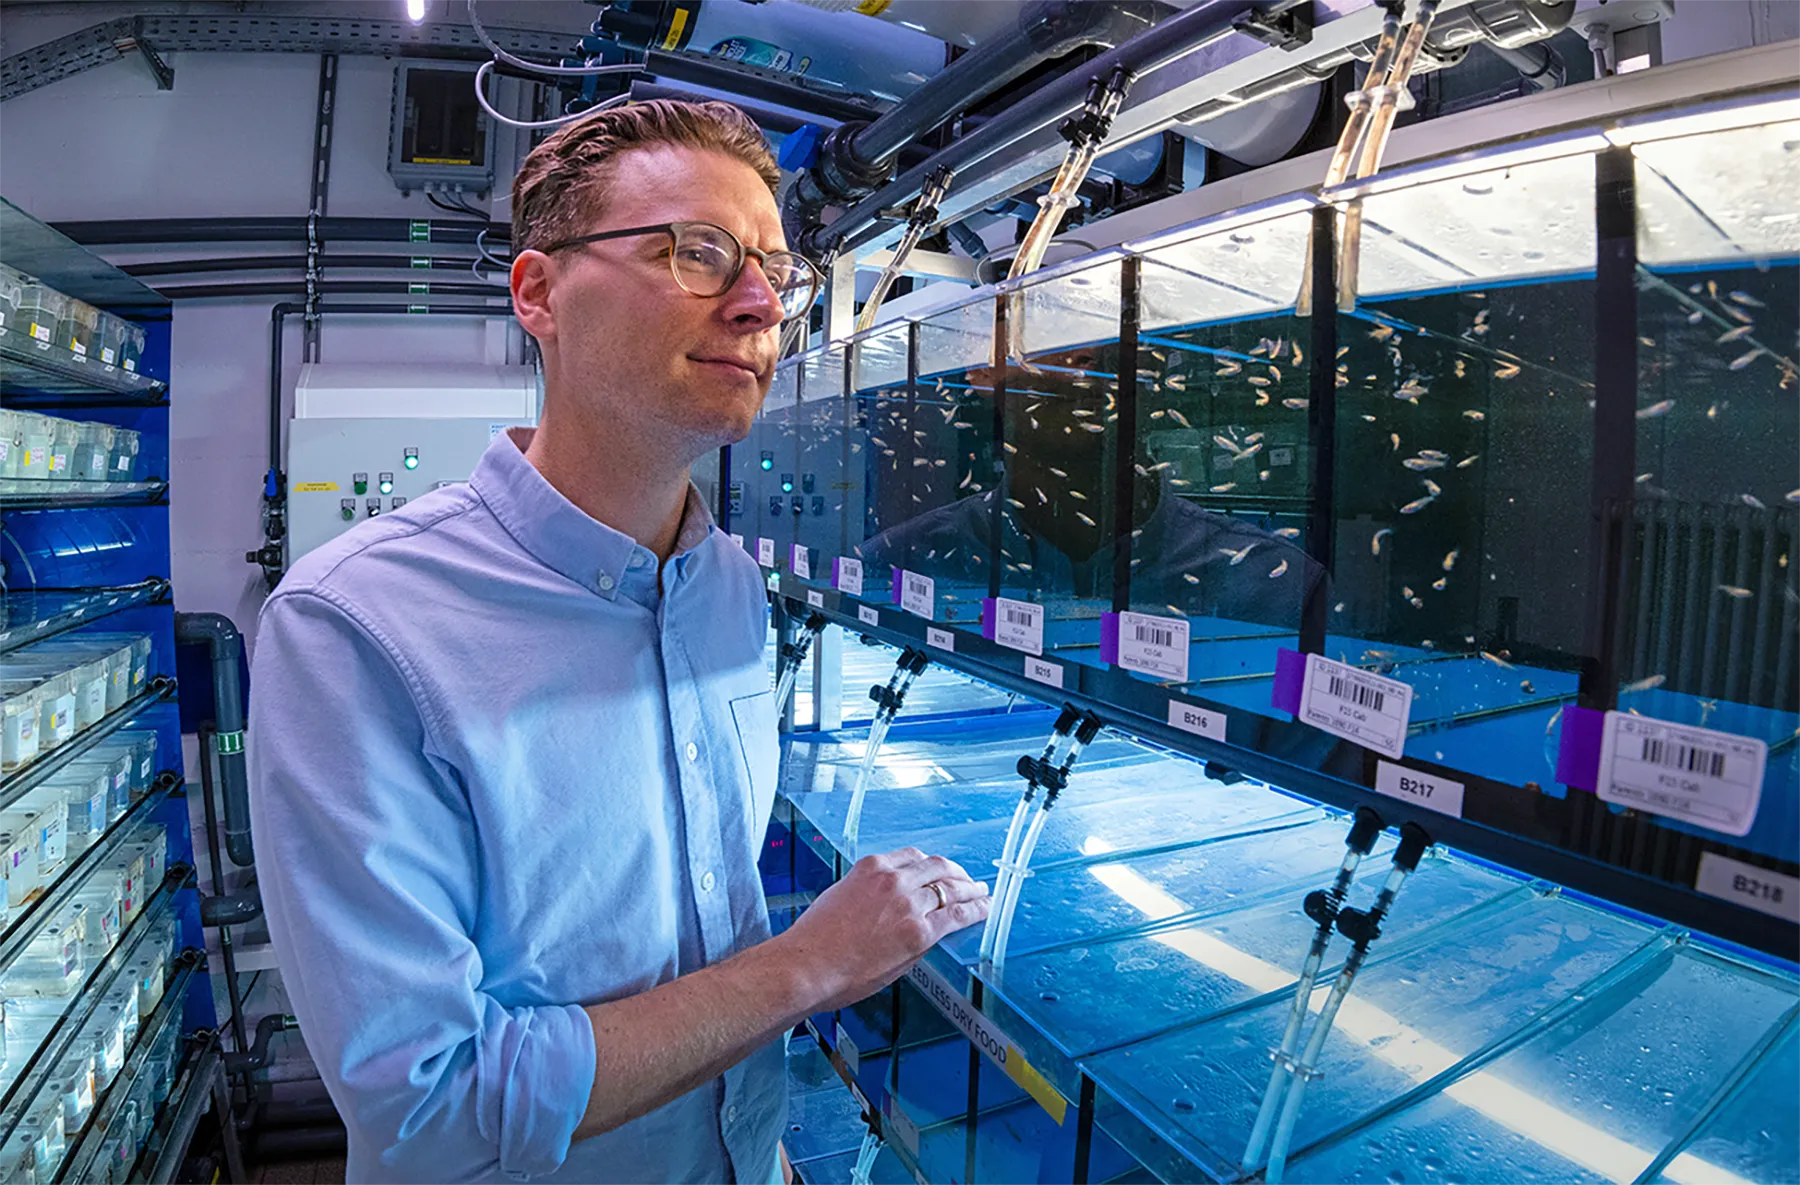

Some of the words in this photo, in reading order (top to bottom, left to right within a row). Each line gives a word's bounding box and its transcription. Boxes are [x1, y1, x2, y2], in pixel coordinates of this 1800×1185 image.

[1184, 711, 1208, 728] B216
[1399, 776, 1435, 799] B217
[1733, 873, 1784, 905] B218
[911, 966, 930, 989] EED
[931, 981, 952, 1011] LESS
[953, 1002, 974, 1031] DRY
[975, 1024, 1007, 1064] FOOD
